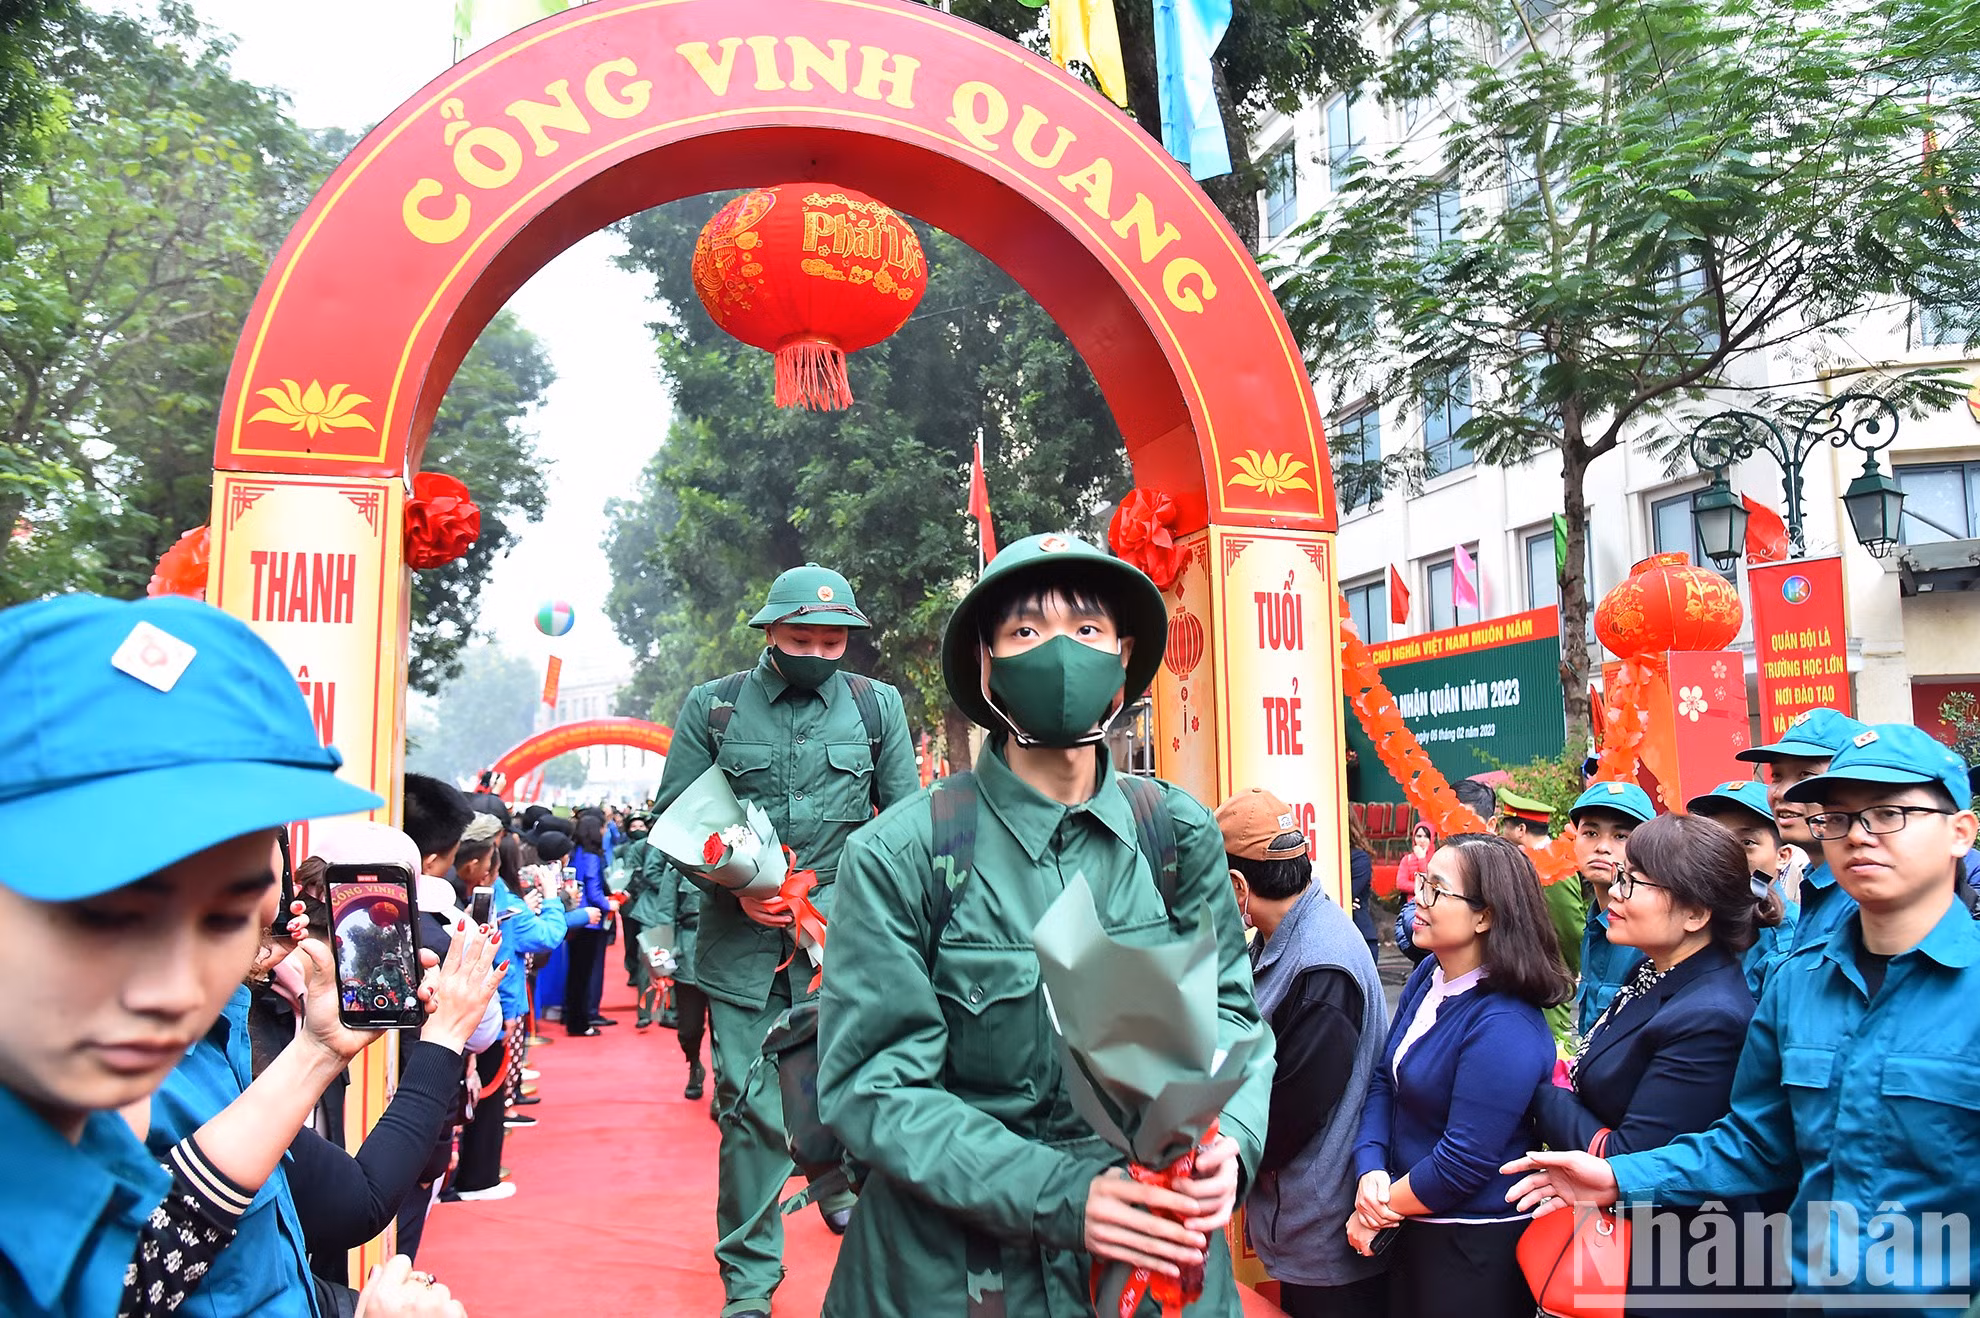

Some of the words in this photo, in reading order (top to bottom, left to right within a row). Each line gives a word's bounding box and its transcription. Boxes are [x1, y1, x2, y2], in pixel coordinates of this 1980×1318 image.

[402, 57, 653, 244] CỔNG
[675, 35, 921, 110] VINH
[945, 80, 1218, 315] QUANG
[802, 211, 882, 260] Phát
[250, 550, 357, 624] THANH
[1254, 569, 1304, 652] TUỔI
[1372, 644, 1391, 665] CHỦ
[1392, 640, 1421, 662] NGHĨA
[1422, 636, 1443, 657] VIỆT
[1445, 632, 1470, 651] NAM
[1471, 625, 1503, 646] MUÔN
[1506, 619, 1533, 640] NĂM
[1771, 629, 1799, 652] QUÂN
[1799, 627, 1817, 652] ĐỘI
[1818, 625, 1831, 648] LÀ
[1764, 656, 1801, 680] TRƯỜNG
[1802, 657, 1823, 680] HỌC
[1824, 652, 1844, 675] LỚN
[1262, 676, 1304, 756] TRẺ
[1399, 687, 1429, 722] NHẬN
[1429, 682, 1460, 718] QUÂN
[1461, 678, 1489, 712] NĂM
[1490, 677, 1521, 709] 2023
[1775, 685, 1793, 706] NƠI
[1794, 683, 1815, 704] ĐÀO
[1815, 684, 1835, 707] TẠO
[1438, 727, 1456, 743] tháng
[1465, 725, 1479, 739] năm
[1480, 722, 1496, 738] 2023
[1773, 711, 1787, 733] VÀ
[364, 885, 395, 896] VINH
